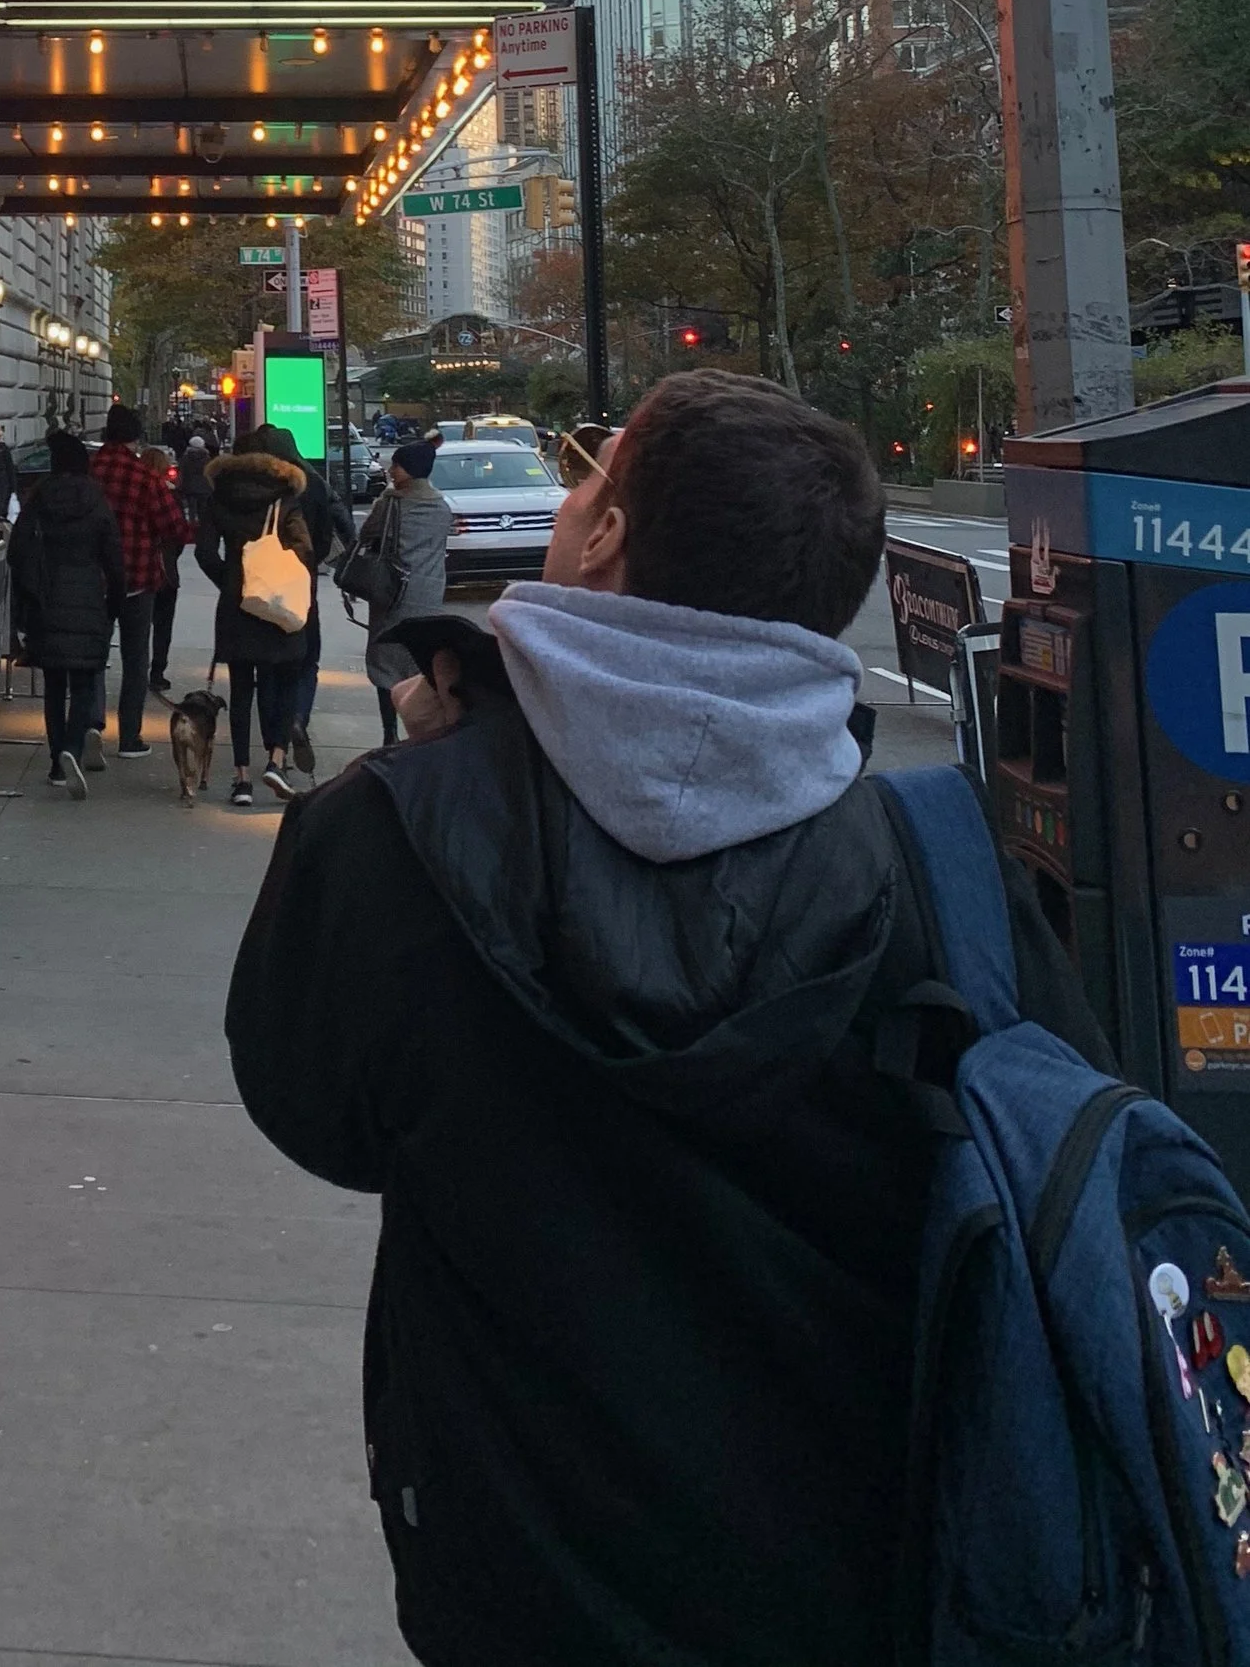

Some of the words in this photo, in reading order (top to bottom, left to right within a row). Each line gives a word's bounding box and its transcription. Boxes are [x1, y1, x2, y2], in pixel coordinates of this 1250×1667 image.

[499, 24, 515, 37] NO
[518, 17, 570, 35] PARKING
[500, 38, 547, 57] Anytime
[429, 196, 444, 212] W
[452, 193, 471, 210] 74
[478, 190, 495, 207] St
[256, 248, 270, 262] 74
[1188, 964, 1248, 1002] 114
